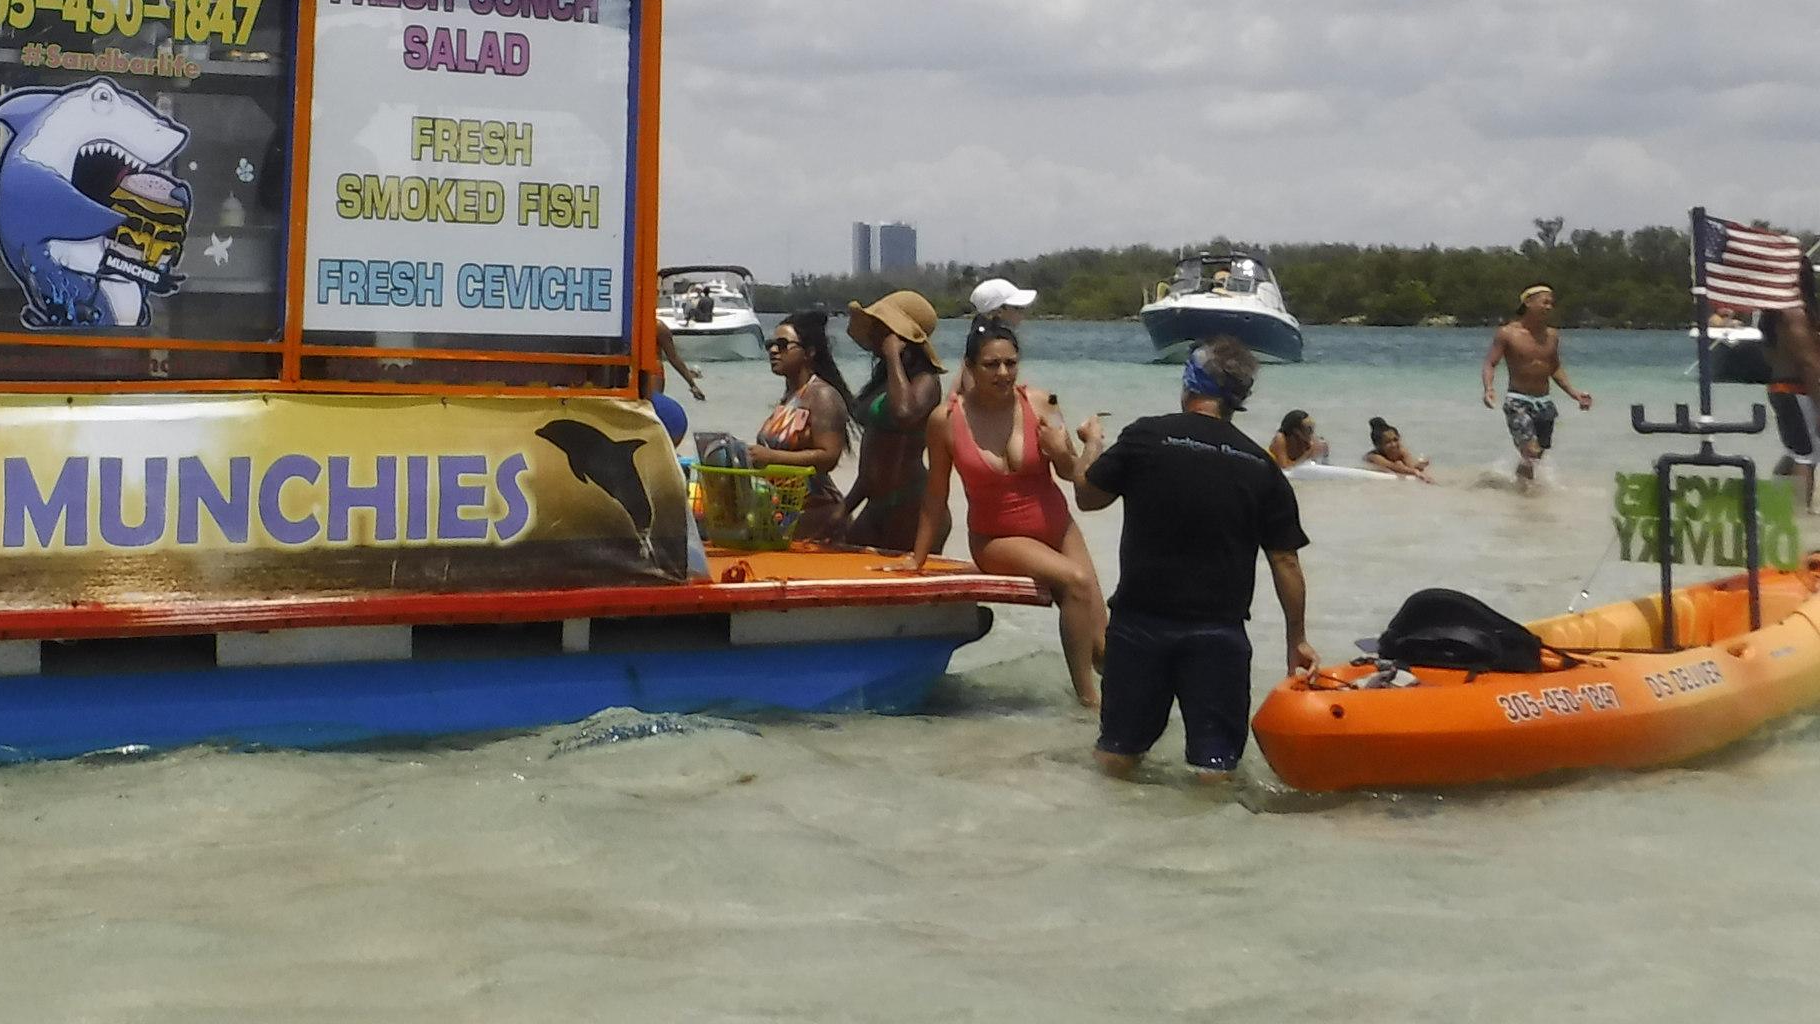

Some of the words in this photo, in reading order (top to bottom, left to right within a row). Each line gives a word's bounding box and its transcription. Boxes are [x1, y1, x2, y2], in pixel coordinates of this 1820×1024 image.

[403, 25, 531, 77] SALAD
[411, 116, 533, 167] FRESH
[336, 174, 505, 224] SMOKED
[518, 182, 599, 229] FISH
[106, 255, 160, 284] MUNCHIES
[317, 258, 443, 307] FRESH
[457, 263, 612, 312] CEVICHE
[3, 452, 532, 549] MUNCHIES
[1498, 683, 1622, 723] 305-450-1847
